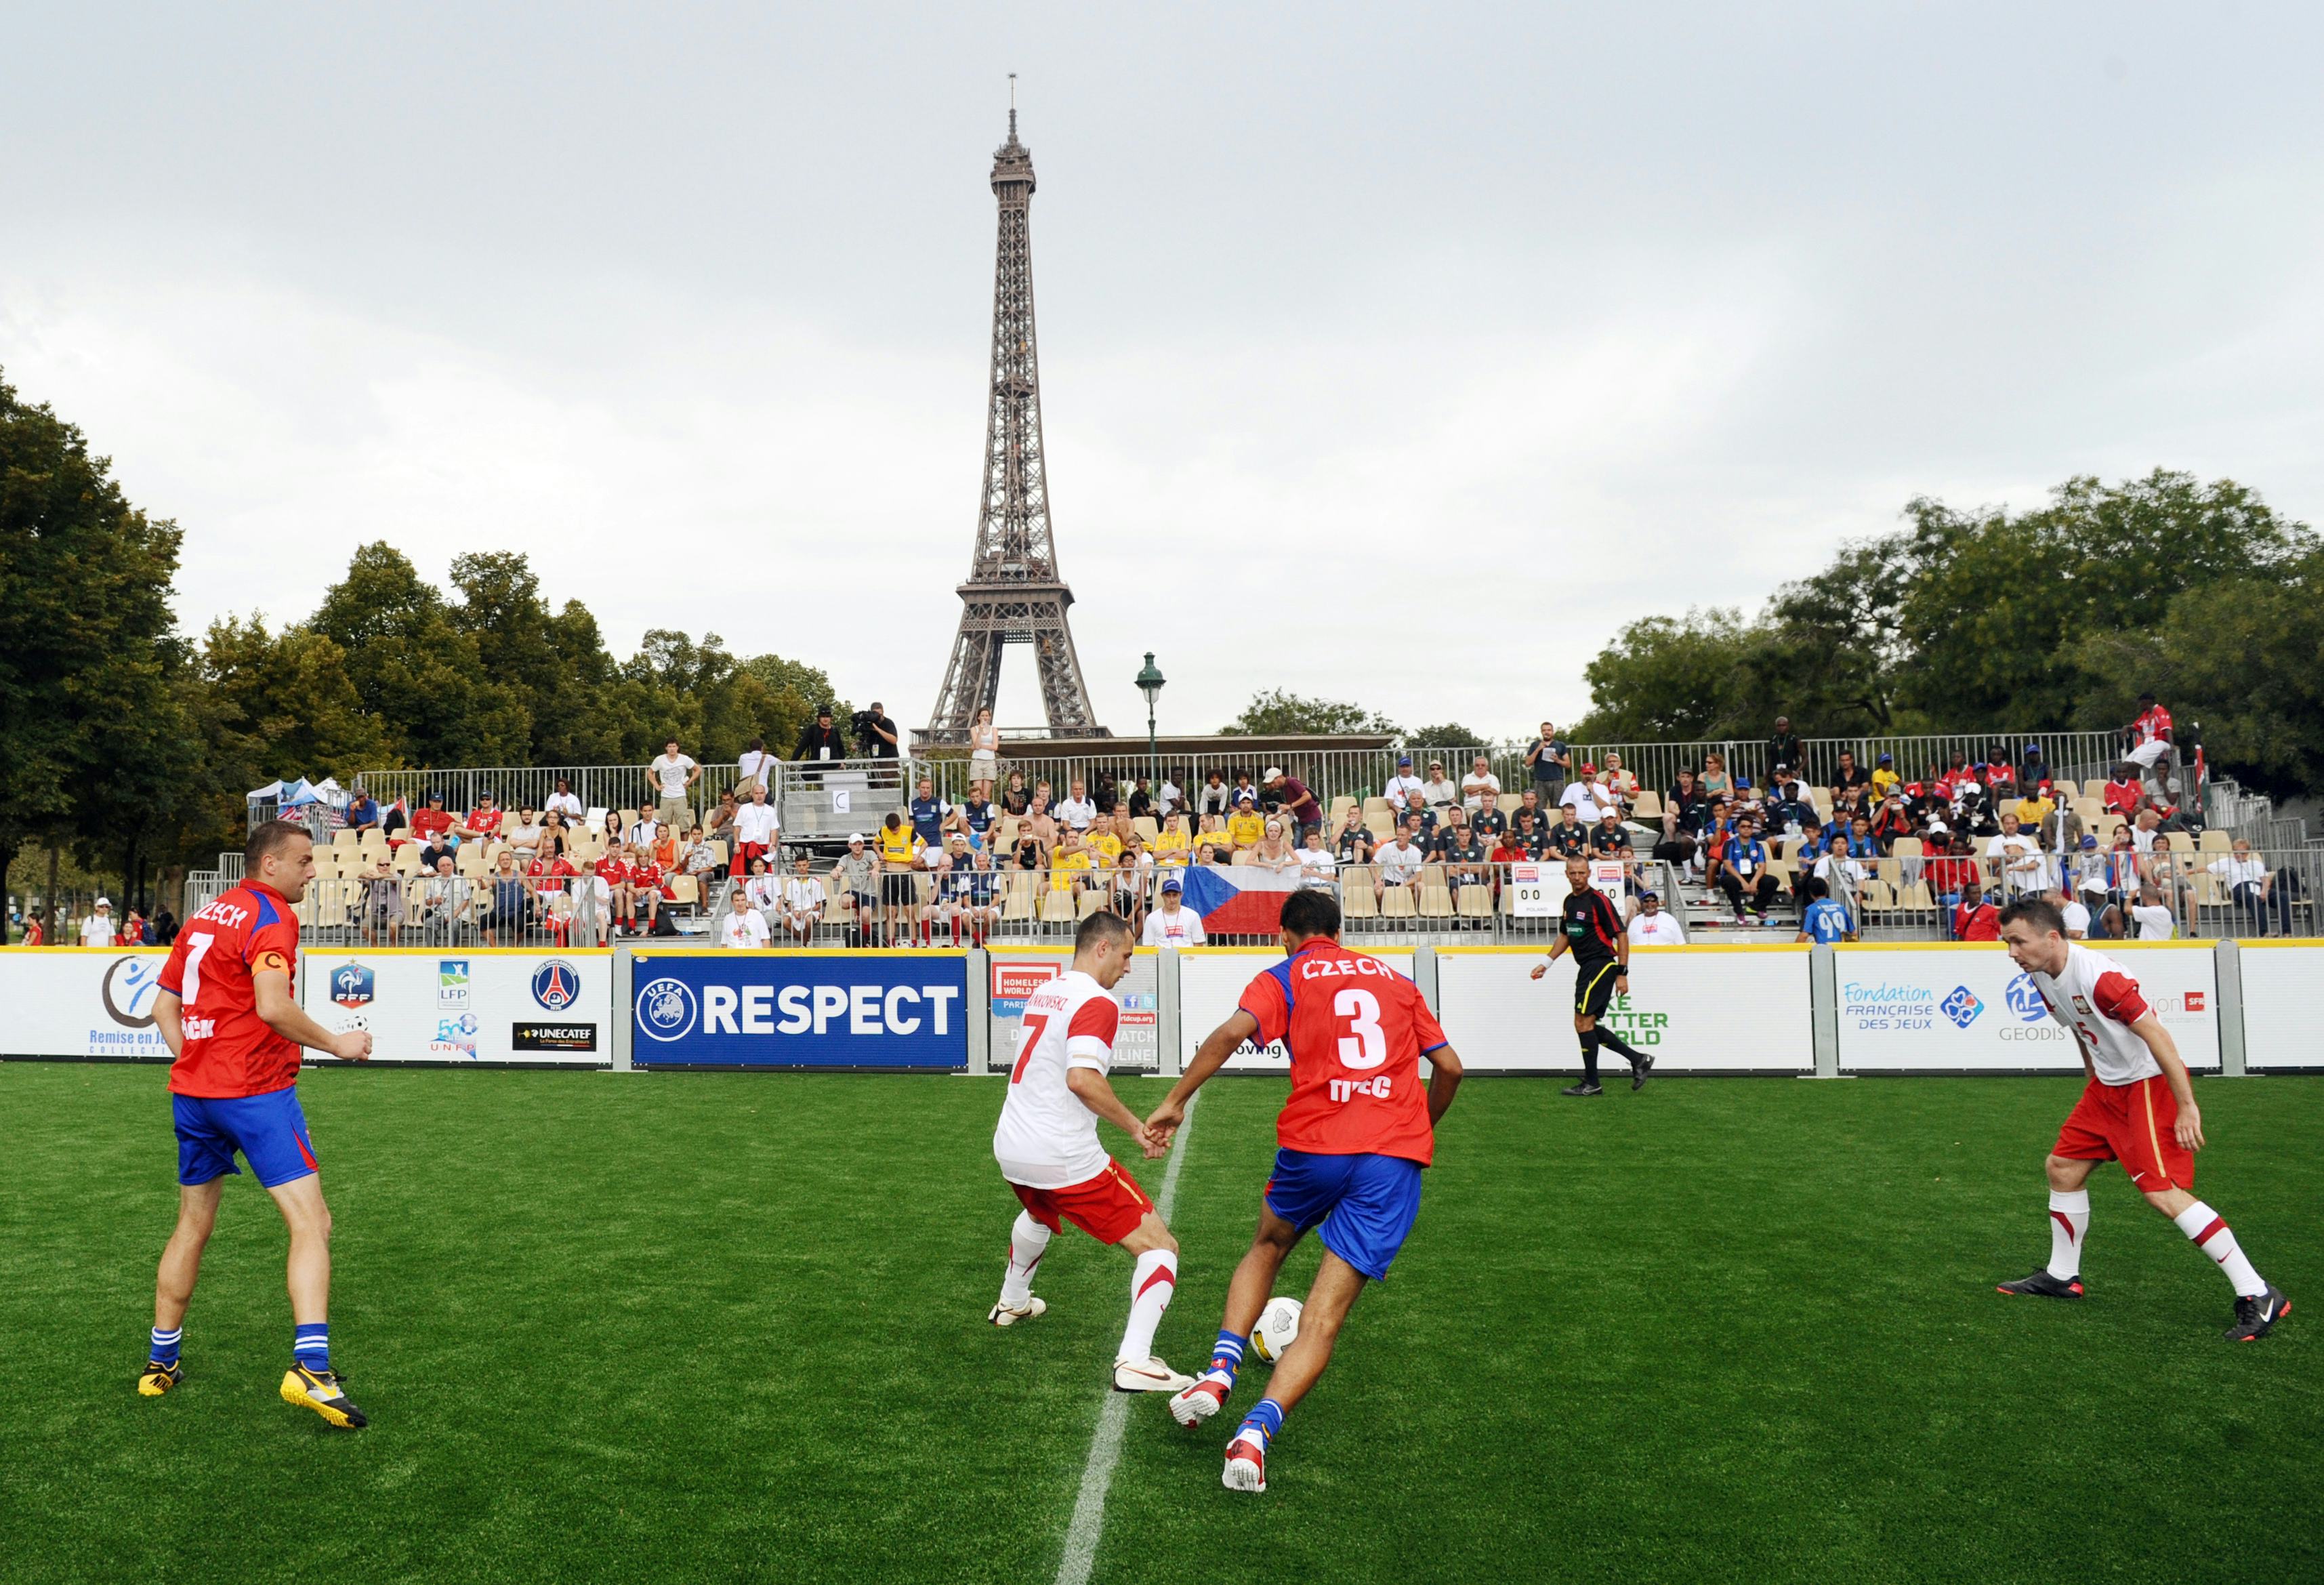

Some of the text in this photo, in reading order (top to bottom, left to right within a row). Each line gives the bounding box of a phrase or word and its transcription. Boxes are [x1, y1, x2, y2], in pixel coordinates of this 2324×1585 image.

[1819, 911, 1845, 939] 99
[182, 931, 215, 1005] 7
[264, 953, 282, 969] C
[1302, 958, 1394, 981] CZECH
[440, 989, 467, 1000] LFP
[647, 983, 682, 997] UEFA
[1844, 981, 1934, 1003] Fondation
[335, 993, 370, 1002] FFF
[703, 985, 958, 1035] RESPECT
[1846, 1005, 1934, 1018] FRANÇAISE
[1120, 1015, 1153, 1023] rldcup.org
[1606, 1013, 1668, 1028] TTER
[1859, 1019, 1932, 1029] DES JEUX
[539, 1029, 592, 1039] UNECATEF
[1117, 1030, 1156, 1043] ATCH
[1334, 989, 1387, 1070] 3
[1999, 1027, 2066, 1041] GEODIS
[89, 1030, 167, 1044] Remise en Je
[1615, 1030, 1661, 1046] RLD
[89, 1046, 165, 1054] COLLECTI
[430, 1044, 474, 1052] UNFP
[1012, 1014, 1050, 1084] 7
[1113, 1048, 1157, 1061] LINE!
[1195, 1041, 1281, 1058] iovng
